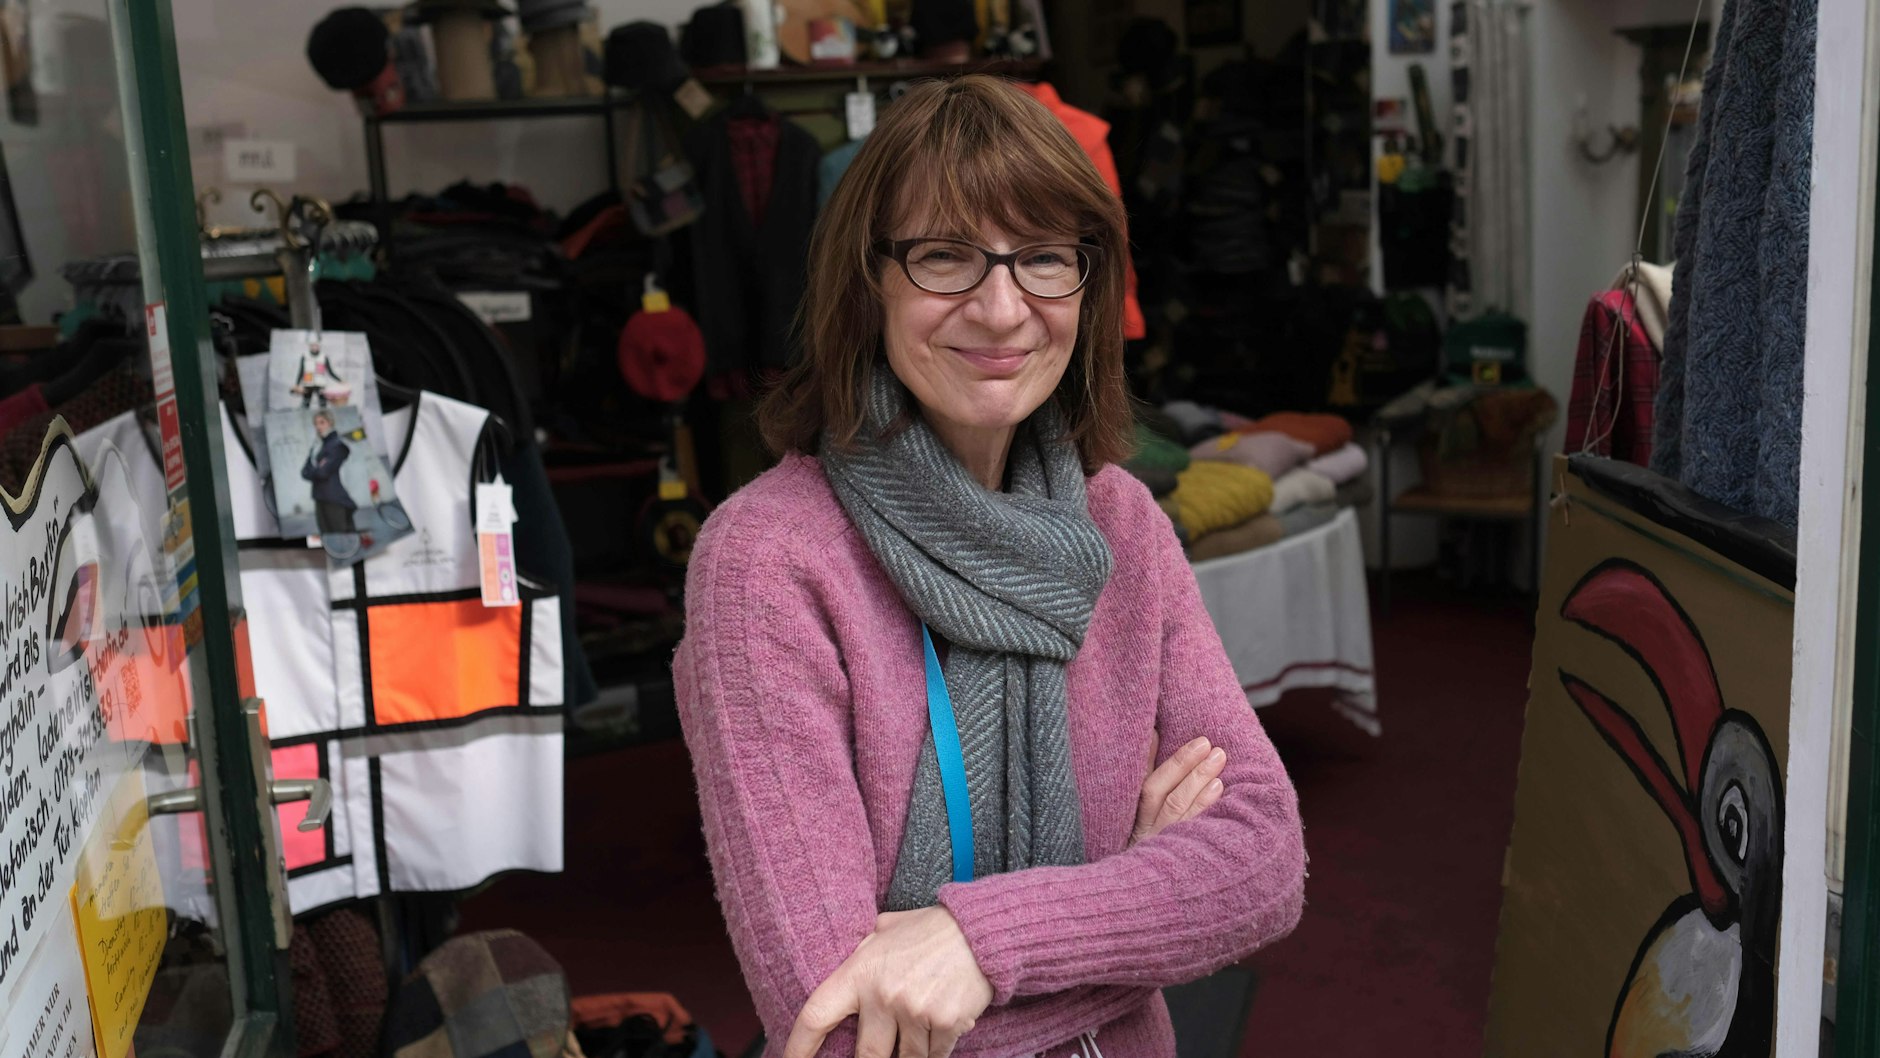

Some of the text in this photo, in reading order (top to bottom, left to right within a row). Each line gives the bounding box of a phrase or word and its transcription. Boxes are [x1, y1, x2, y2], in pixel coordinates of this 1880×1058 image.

[23, 625, 40, 675] als
[0, 685, 36, 777] rghain
[0, 788, 53, 904] lefonisch:
[21, 894, 37, 931] an
[38, 857, 55, 903] der
[53, 814, 71, 865] Tür
[69, 767, 101, 839] klopfen
[44, 983, 60, 1020] NUR
